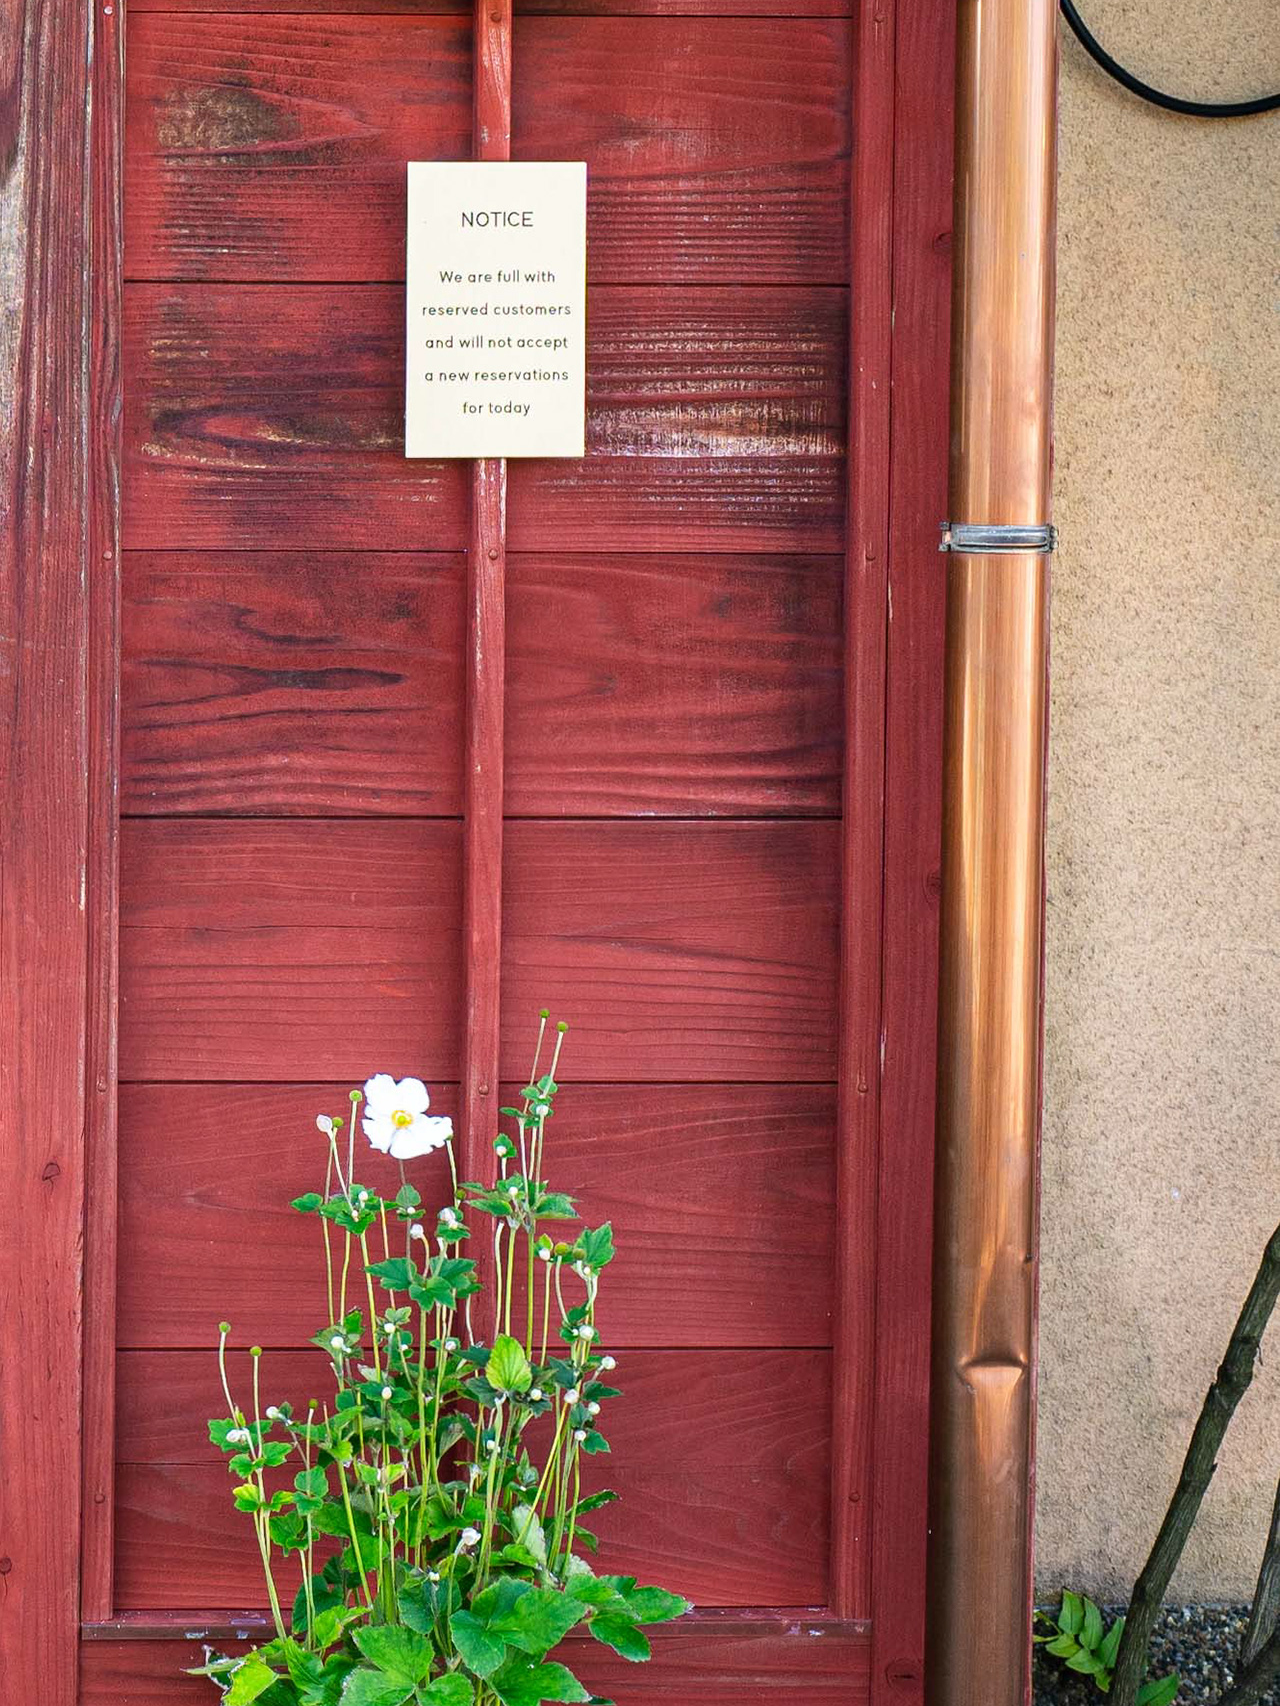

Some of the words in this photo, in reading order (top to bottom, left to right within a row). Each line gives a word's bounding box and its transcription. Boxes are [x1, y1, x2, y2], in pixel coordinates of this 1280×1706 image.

[461, 211, 534, 228] NOTICE
[439, 270, 463, 283] We
[467, 272, 493, 283] are
[497, 269, 520, 283] full
[524, 270, 556, 283] with
[422, 302, 489, 316] reserved
[493, 304, 572, 316] customers
[425, 335, 454, 349] and
[458, 335, 484, 349] will
[487, 336, 513, 349] not
[516, 337, 569, 351] accept
[424, 372, 435, 382] a
[438, 372, 470, 382] new
[474, 368, 569, 382] reservations
[462, 401, 484, 415] for
[488, 400, 531, 416] today
